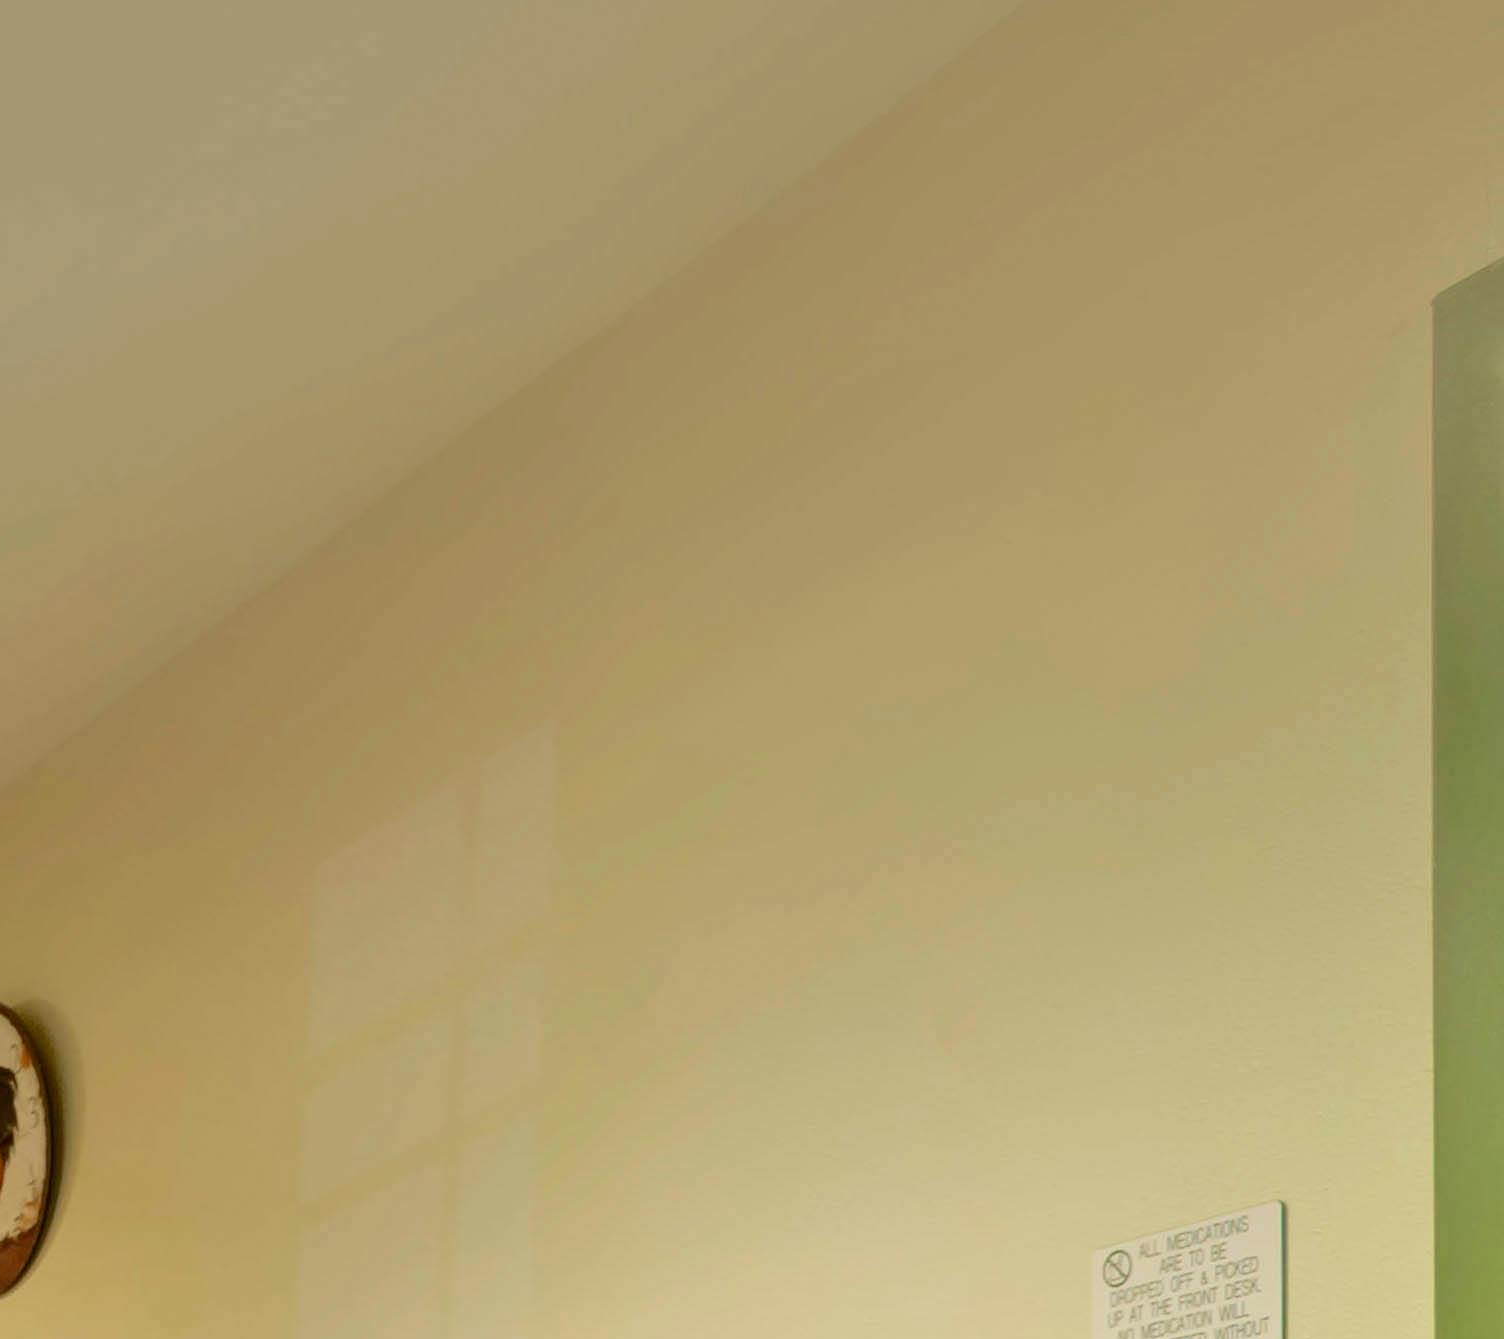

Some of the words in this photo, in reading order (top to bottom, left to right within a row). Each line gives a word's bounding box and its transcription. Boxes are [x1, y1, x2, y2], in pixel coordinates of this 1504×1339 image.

[1139, 1239, 1160, 1259] ALL
[1166, 1215, 1249, 1250] MEDICATIONS
[1160, 1254, 1183, 1274] ARE
[1189, 1249, 1205, 1267] TO
[1210, 1242, 1227, 1262] BE
[1110, 1280, 1163, 1307] DROPPED
[1171, 1272, 1193, 1292] OFF
[1201, 1271, 1208, 1285] &
[1215, 1256, 1259, 1281] PICKED
[1107, 1310, 1124, 1328] UP
[1129, 1305, 1144, 1321] AT
[1151, 1299, 1171, 1317] THE
[1178, 1287, 1218, 1310] FRONT
[1141, 1310, 1213, 1339] MEDICATION
[1219, 1301, 1249, 1322] WILL
